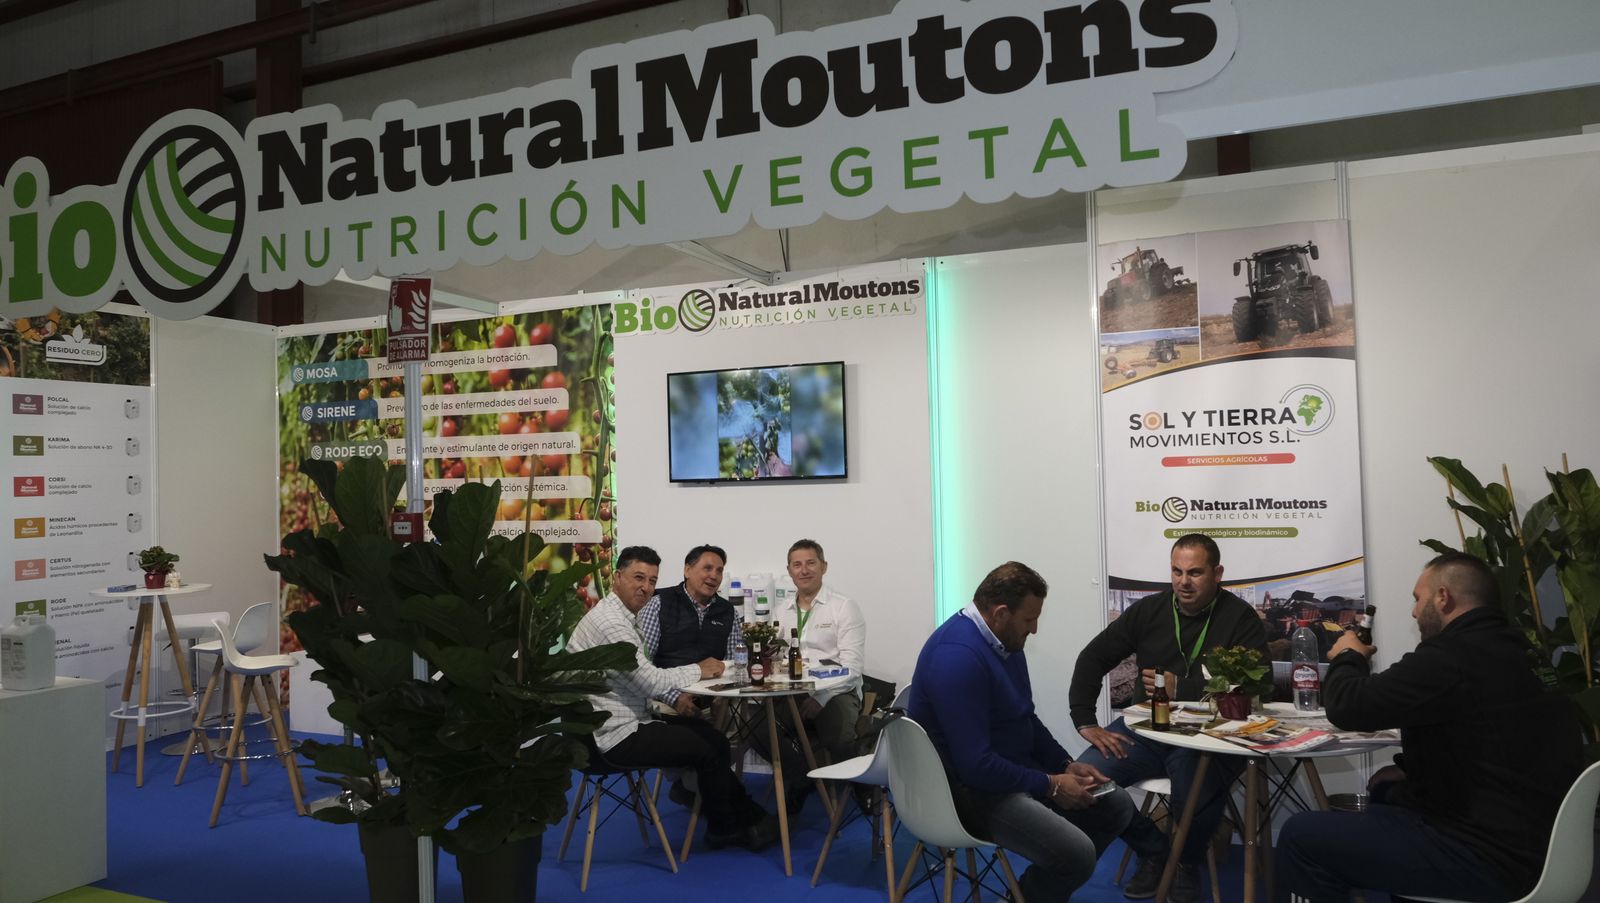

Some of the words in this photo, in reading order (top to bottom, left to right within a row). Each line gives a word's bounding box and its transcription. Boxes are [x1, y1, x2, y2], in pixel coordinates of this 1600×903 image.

[261, 180, 646, 273] NUTRICIÓN
[704, 108, 1160, 213] VEGETAL
[0, 171, 117, 303] io
[614, 297, 677, 333] Bio
[719, 308, 817, 327] NUTRICIÓN
[827, 302, 912, 318] VEGETAL
[47, 346, 80, 355] RESIDUO
[389, 339, 427, 351] PULSADOR
[396, 349, 427, 360] ALARMA
[477, 355, 485, 364] la
[486, 353, 531, 364] brotación.
[306, 367, 338, 379] MOSA
[429, 401, 439, 411] de
[441, 401, 453, 411] las
[455, 397, 516, 409] enfermedades
[517, 396, 532, 406] del
[533, 396, 560, 406] suelo.
[317, 405, 356, 418] SIRENE
[1129, 412, 1175, 431] SOL
[1181, 411, 1197, 428] Y
[1203, 407, 1297, 427] TIERRA
[1130, 431, 1263, 448] MOVIMIENTOS
[1269, 430, 1301, 444] S.L.
[325, 447, 357, 458] RODE
[359, 445, 383, 457] ECO
[439, 446, 445, 456] y
[446, 444, 496, 454] estimulante
[498, 442, 509, 452] de
[511, 441, 540, 453] origen
[541, 440, 576, 450] natural.
[1186, 457, 1225, 465] SERVICIOS
[1226, 455, 1268, 464] AGRÍCOLAS
[524, 483, 569, 492] sstémica.
[1135, 501, 1161, 513] Bio
[1191, 511, 1259, 520] NUTRICIÓN
[1267, 511, 1323, 519] VEGETAL
[530, 526, 581, 537] omplejado.
[1244, 529, 1289, 537] biodinámico
